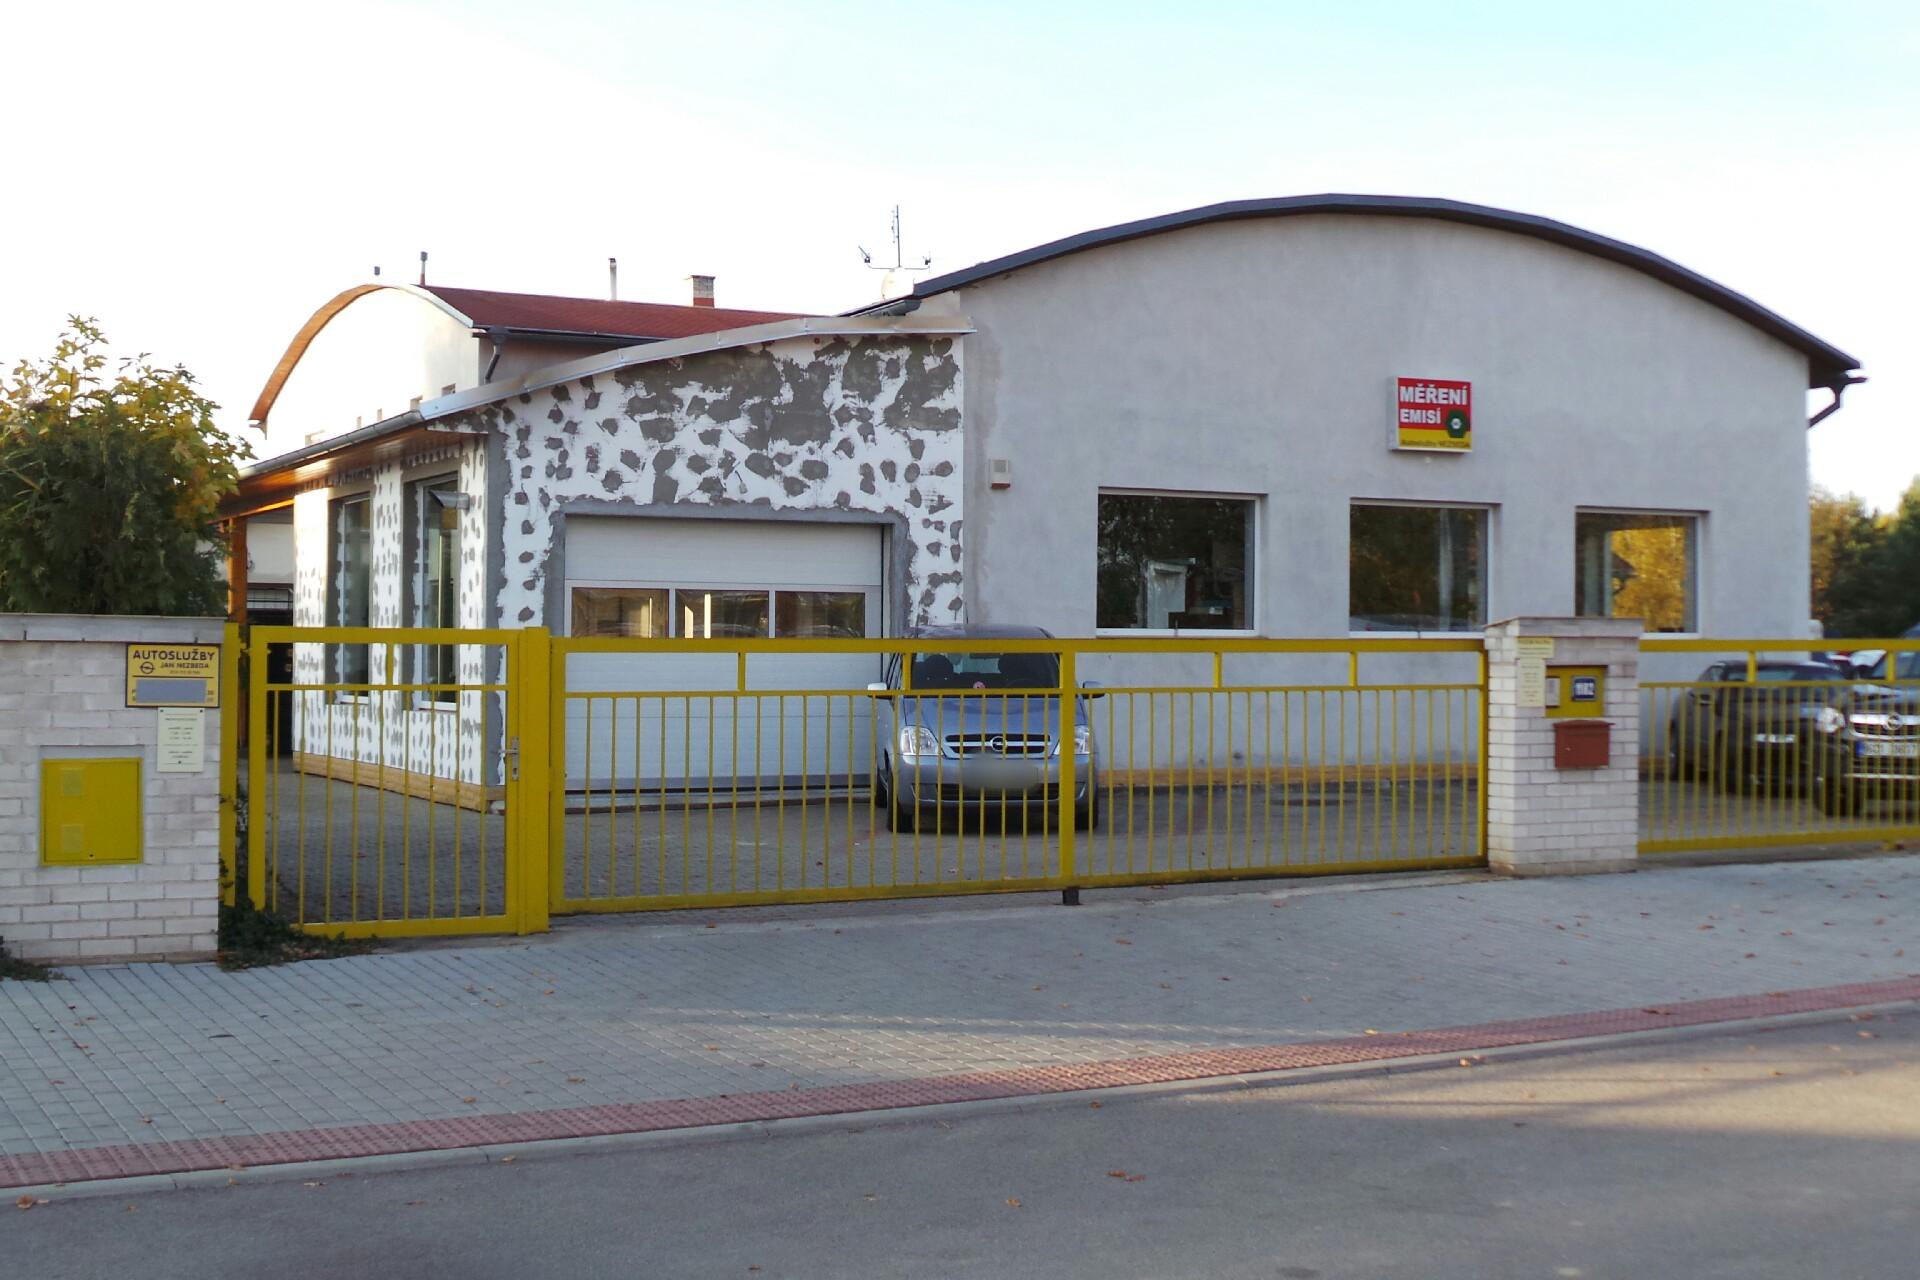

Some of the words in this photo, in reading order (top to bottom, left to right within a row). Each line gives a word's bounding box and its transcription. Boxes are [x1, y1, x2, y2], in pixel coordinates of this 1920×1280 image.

[1400, 383, 1467, 405] MĚŘENÍ
[1400, 407, 1441, 424] EMISÍ
[133, 648, 215, 661] AUTOSLUŽBY
